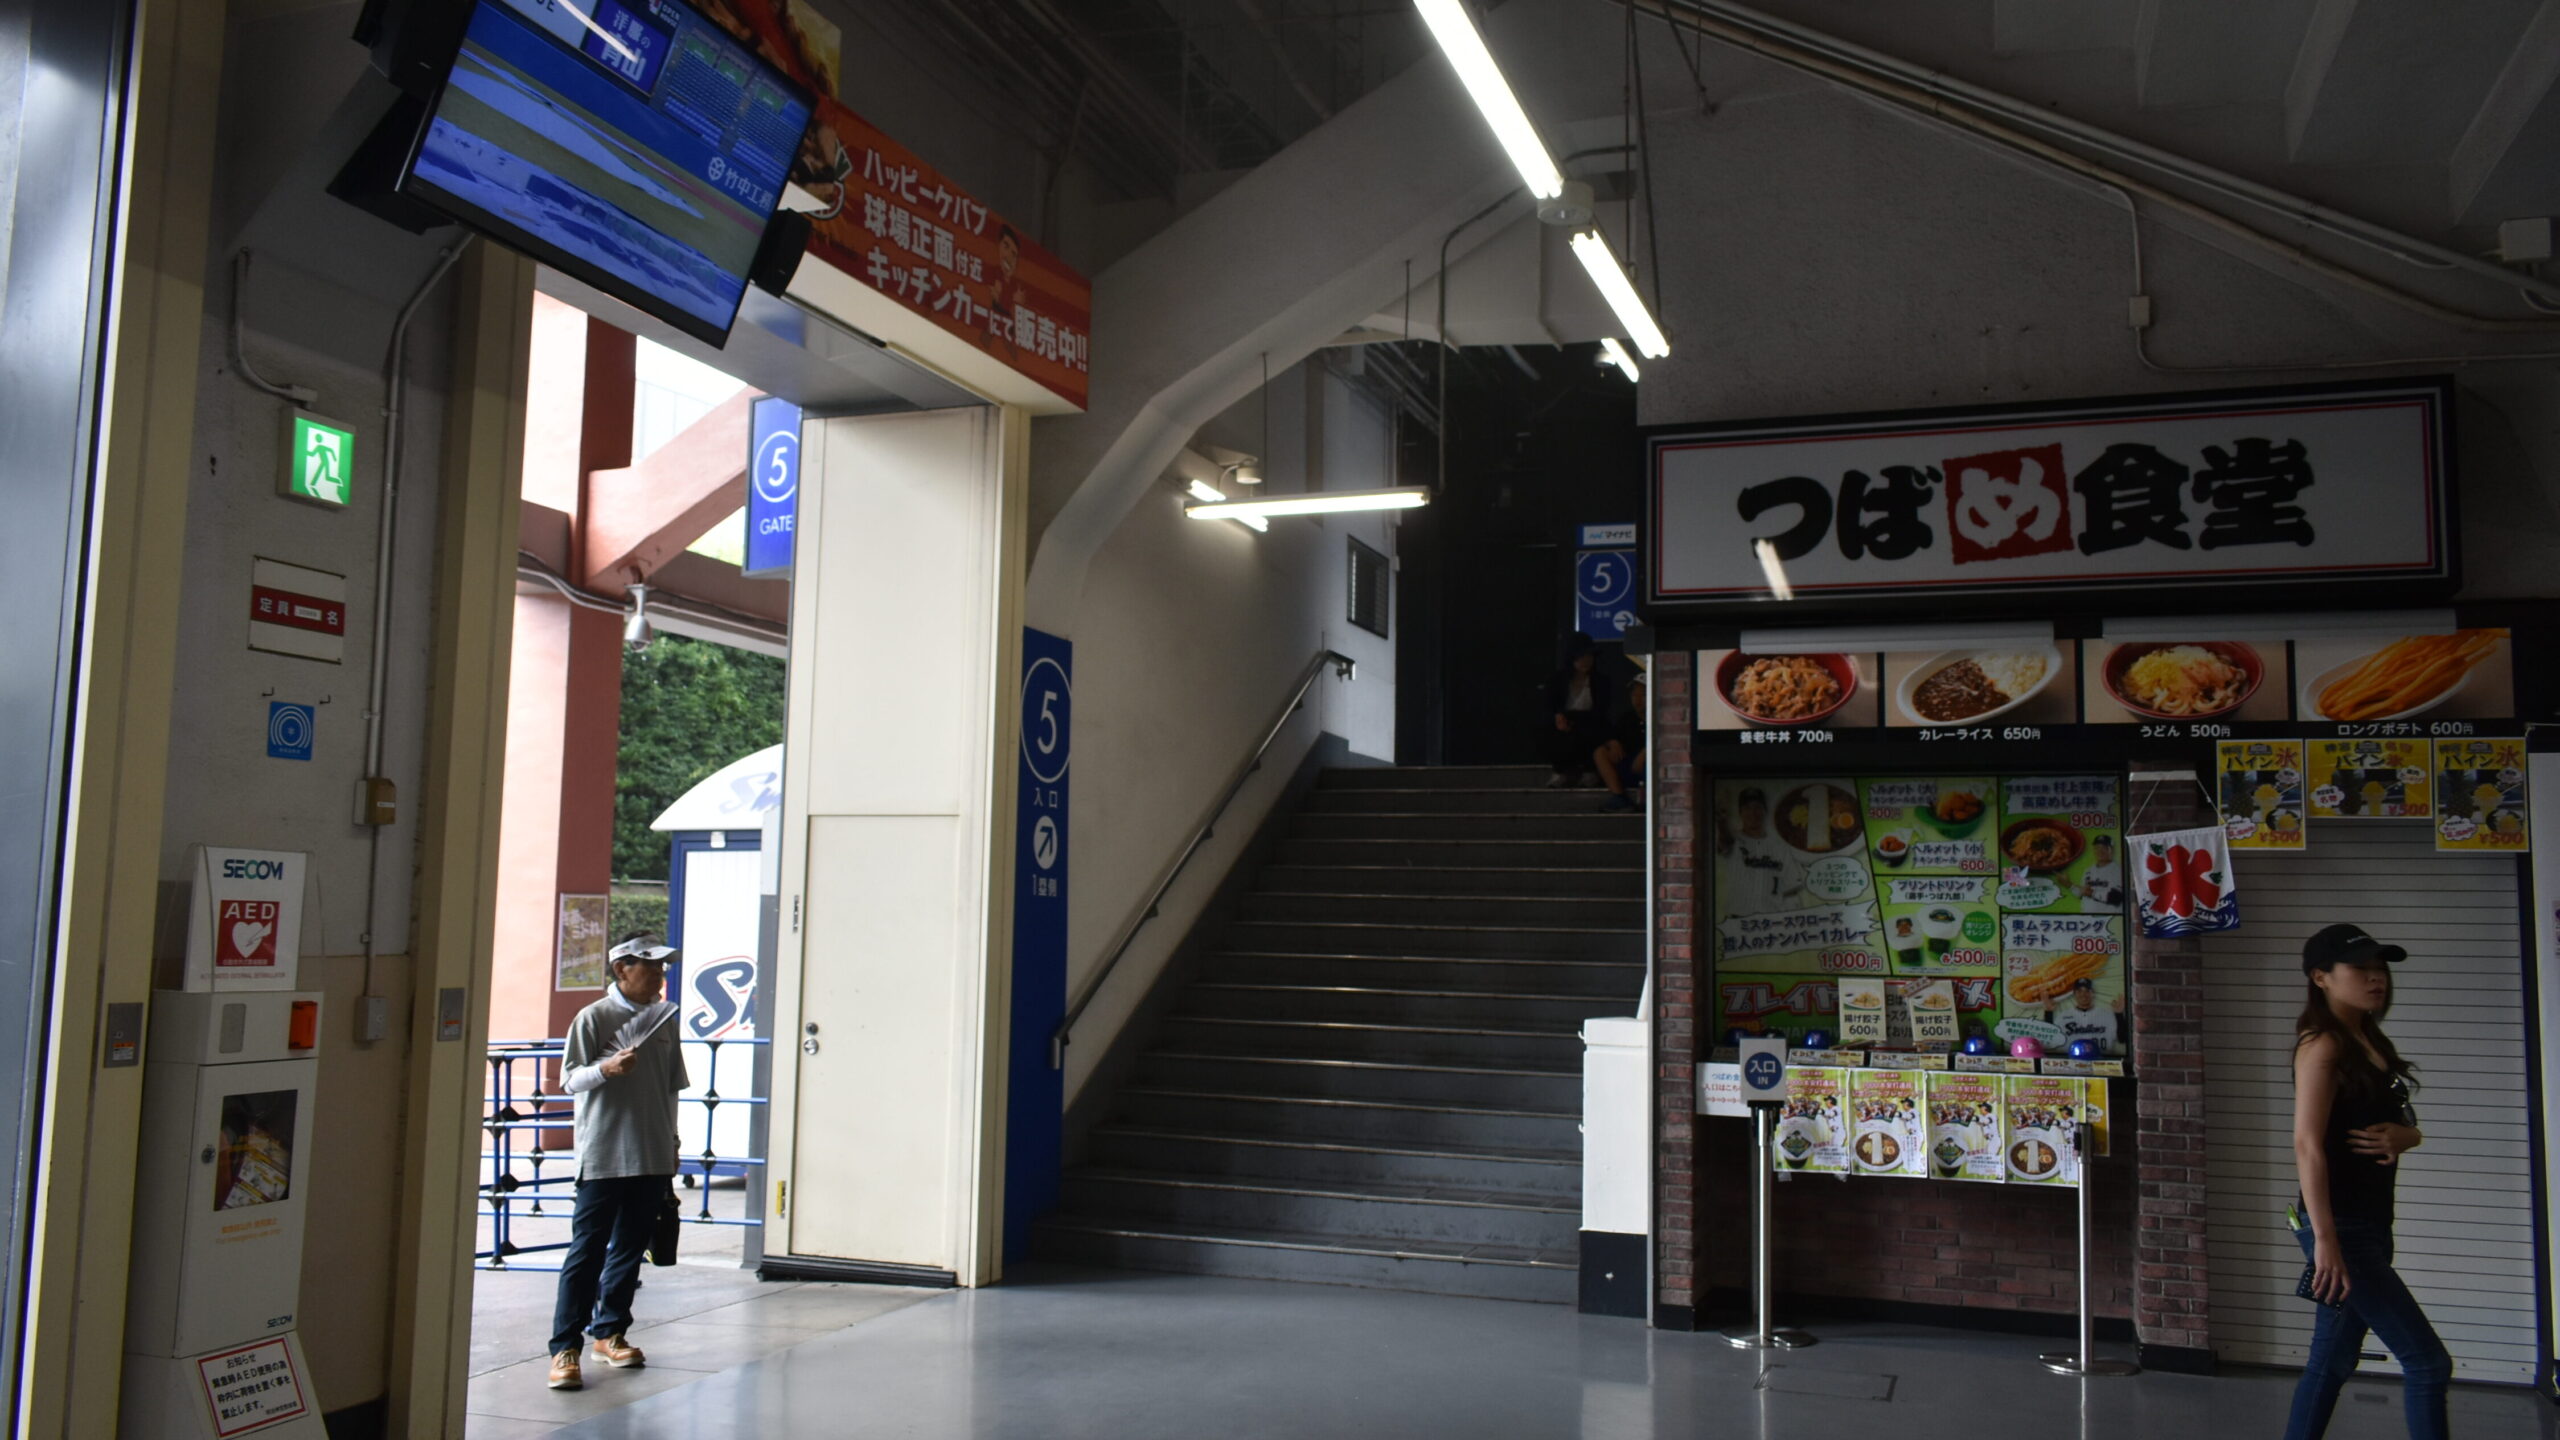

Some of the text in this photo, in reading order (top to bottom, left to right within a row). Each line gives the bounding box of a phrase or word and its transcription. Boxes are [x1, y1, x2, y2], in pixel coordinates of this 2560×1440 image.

[863, 147, 988, 236] ハッピーケバブ
[863, 193, 983, 283] 球場正面付近
[768, 446, 788, 487] 5
[1737, 437, 2315, 561] つばめ食堂
[760, 515, 792, 535] GATE
[1591, 562, 1612, 593] 5
[1037, 689, 1058, 754] 5
[2338, 721, 2473, 736] ロングポテト 600円
[1798, 730, 1833, 744] 700円
[1919, 727, 2041, 741] カレーライス 650円
[2139, 723, 2231, 738] うどん 500円
[1033, 786, 1058, 808] 入口
[2071, 813, 2117, 828] 900円
[223, 858, 284, 880] SECOM
[1898, 880, 1976, 891] プリントドリンク
[224, 902, 277, 920] AED
[2013, 934, 2051, 946] ポテト
[2074, 938, 2119, 952] 800円
[1849, 1025, 1878, 1036] 600円
[1921, 1026, 1951, 1037] 600円
[1749, 1059, 1777, 1074] 入口
[1757, 1076, 1769, 1085] IN
[227, 1353, 256, 1369] お知らせ
